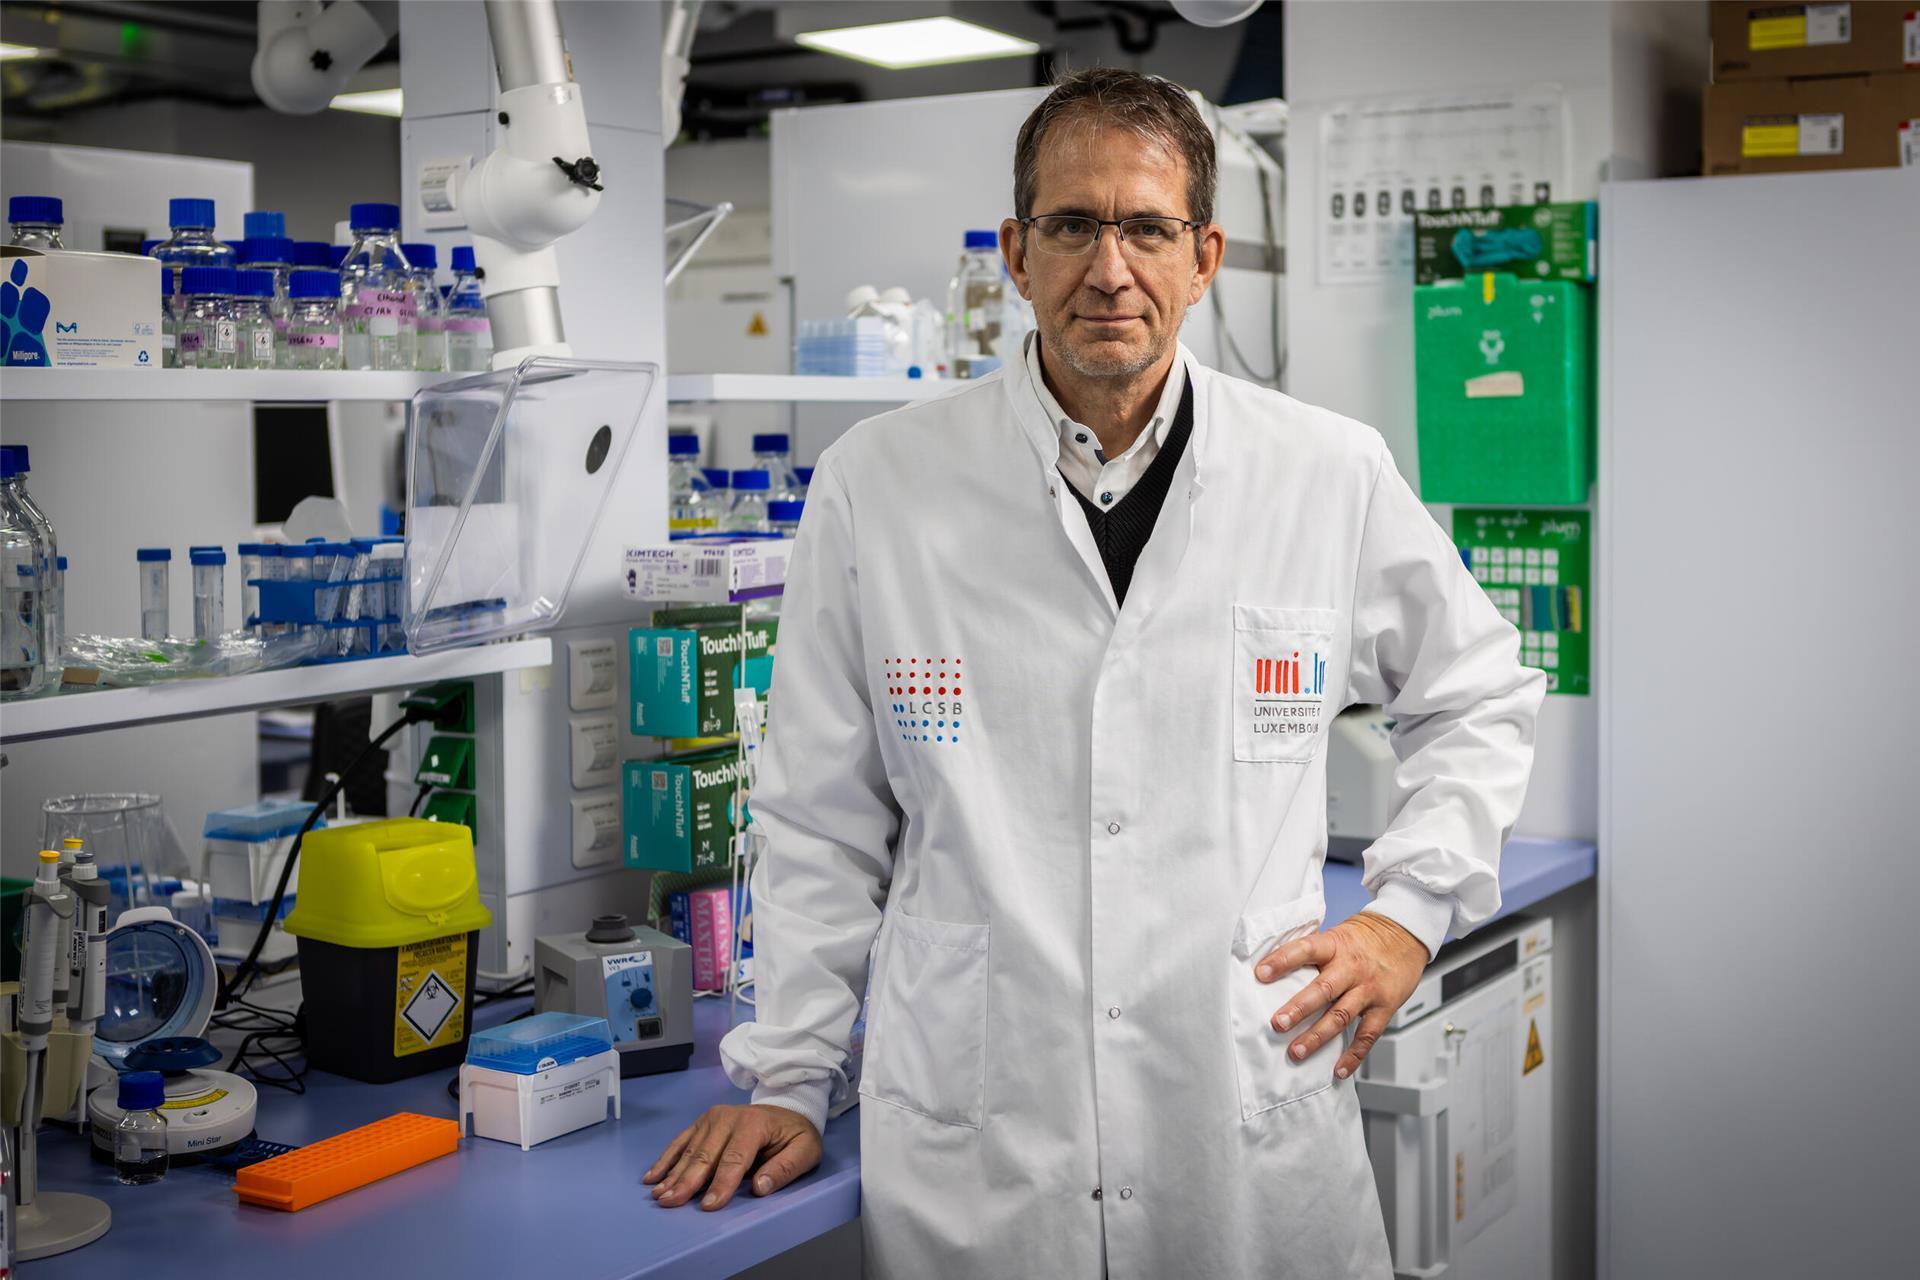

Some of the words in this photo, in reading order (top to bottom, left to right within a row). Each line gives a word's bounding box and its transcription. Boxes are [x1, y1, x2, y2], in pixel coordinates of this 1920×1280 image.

[626, 549, 674, 558] KIMTECH
[681, 638, 691, 704] TouchNTuff
[674, 773, 685, 838] TouchNTuff
[697, 897, 714, 983] MAXTER
[607, 957, 629, 966] VWR
[187, 1139, 205, 1149] Mini
[205, 1135, 222, 1146] Star
